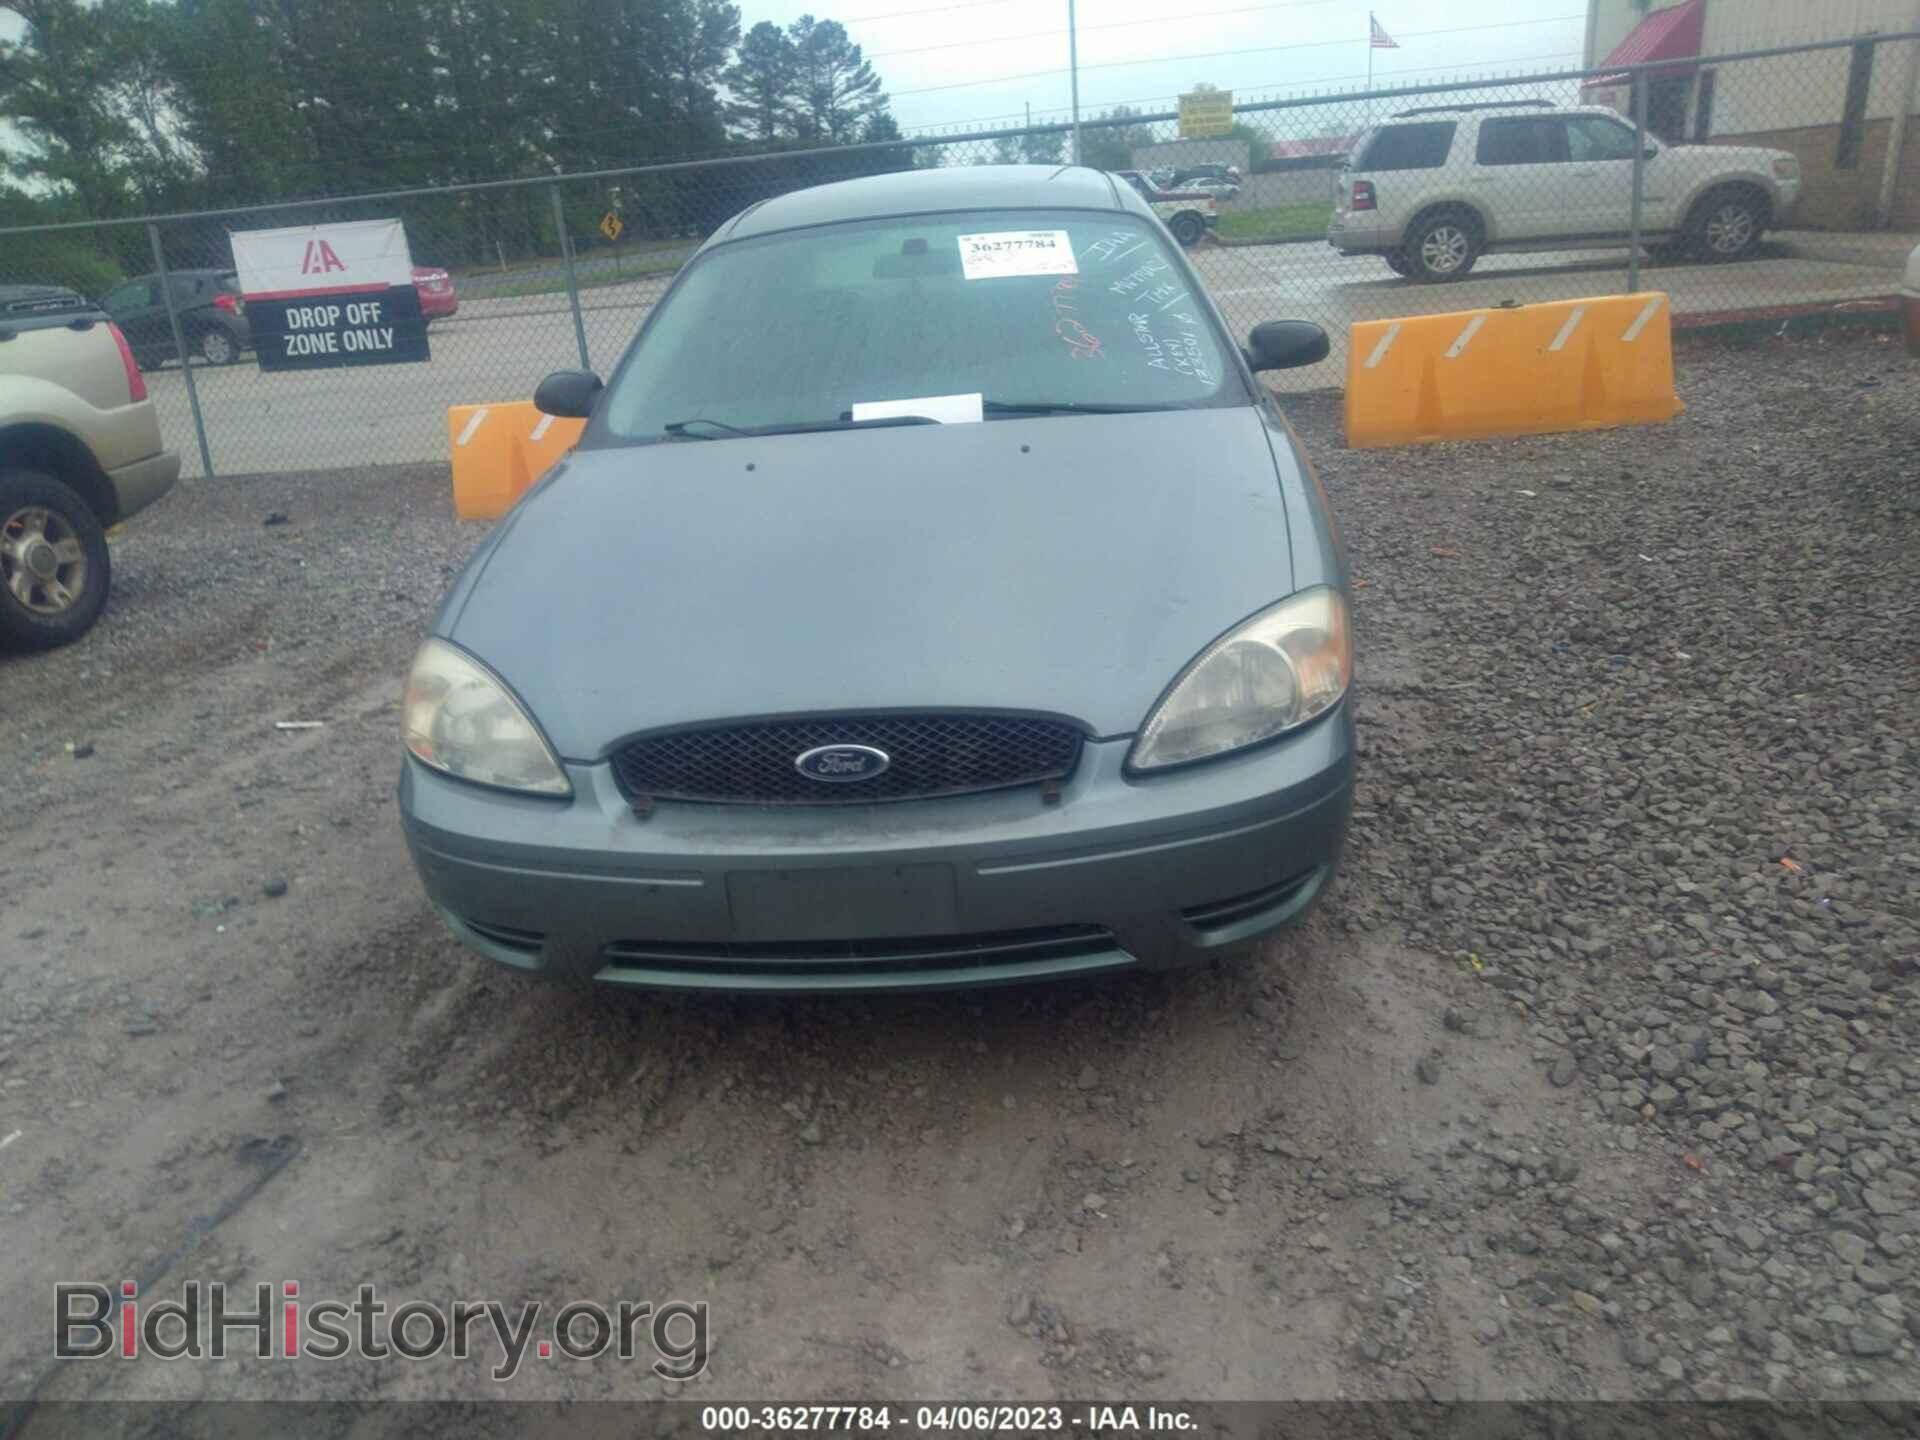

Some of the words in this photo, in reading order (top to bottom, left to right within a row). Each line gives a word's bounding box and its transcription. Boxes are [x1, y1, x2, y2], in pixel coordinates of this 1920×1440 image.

[971, 239, 1056, 253] 36277784
[286, 305, 341, 330] DROP
[346, 302, 382, 325] OFF
[284, 332, 340, 356] ZONE
[343, 328, 394, 351] ONLY
[818, 752, 866, 773] Ford
